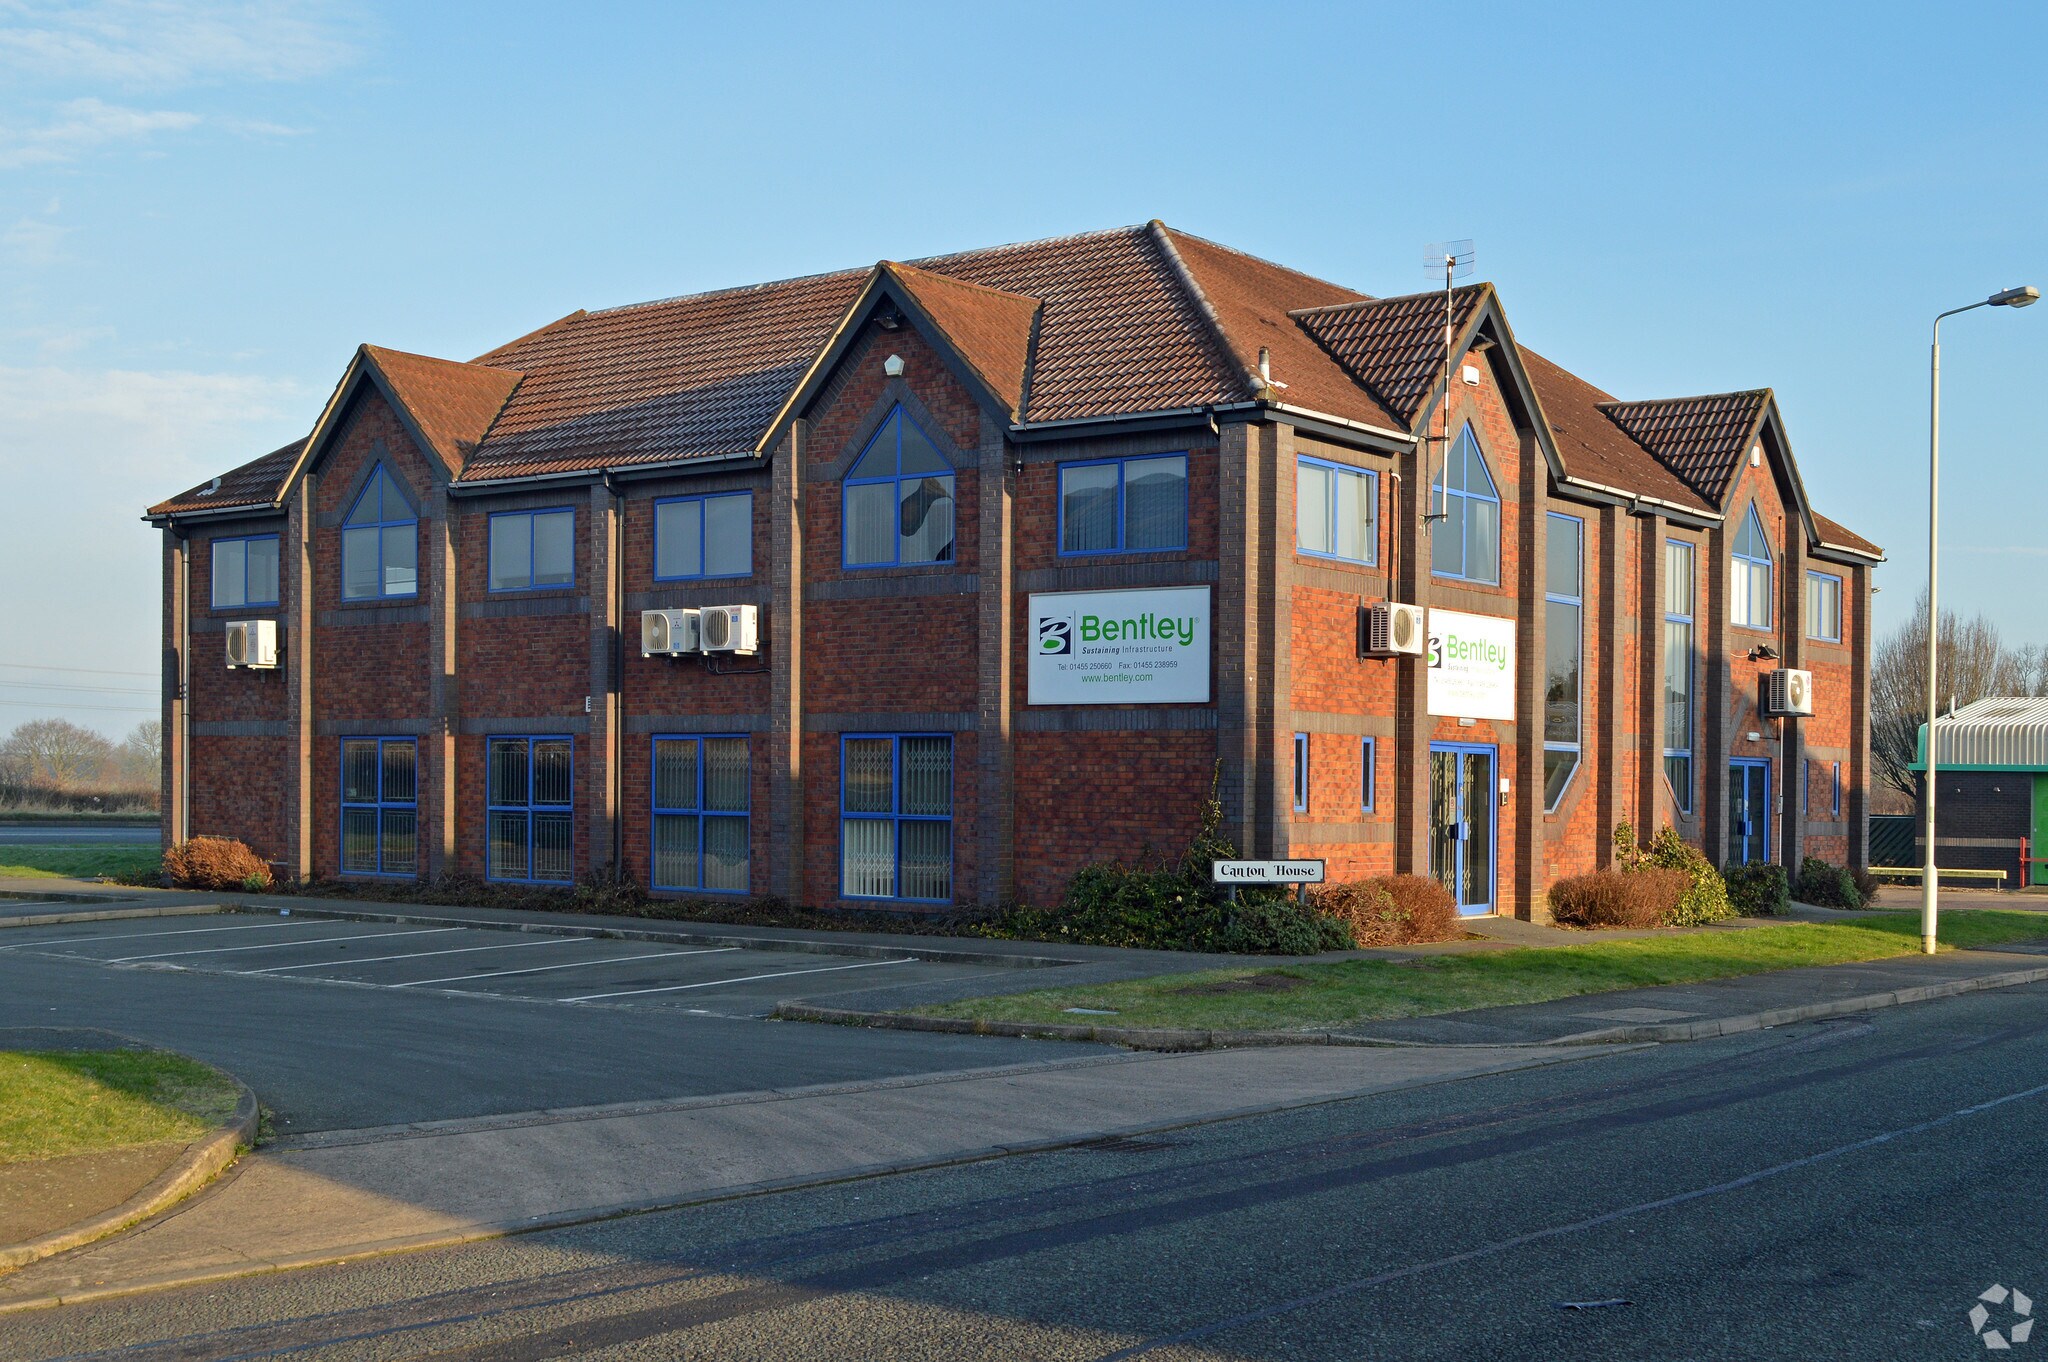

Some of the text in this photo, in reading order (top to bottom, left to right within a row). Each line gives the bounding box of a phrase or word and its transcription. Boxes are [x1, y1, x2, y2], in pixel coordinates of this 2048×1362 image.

[1080, 613, 1194, 646] Bentley
[1082, 645, 1173, 655] Sustaining Infrastructure
[1447, 634, 1505, 670] Bentley
[1069, 663, 1089, 671] 01455
[1133, 661, 1153, 669] 01455
[1154, 660, 1178, 668] 238959
[1081, 673, 1153, 684] www.bentley.com
[1273, 864, 1316, 876] House
